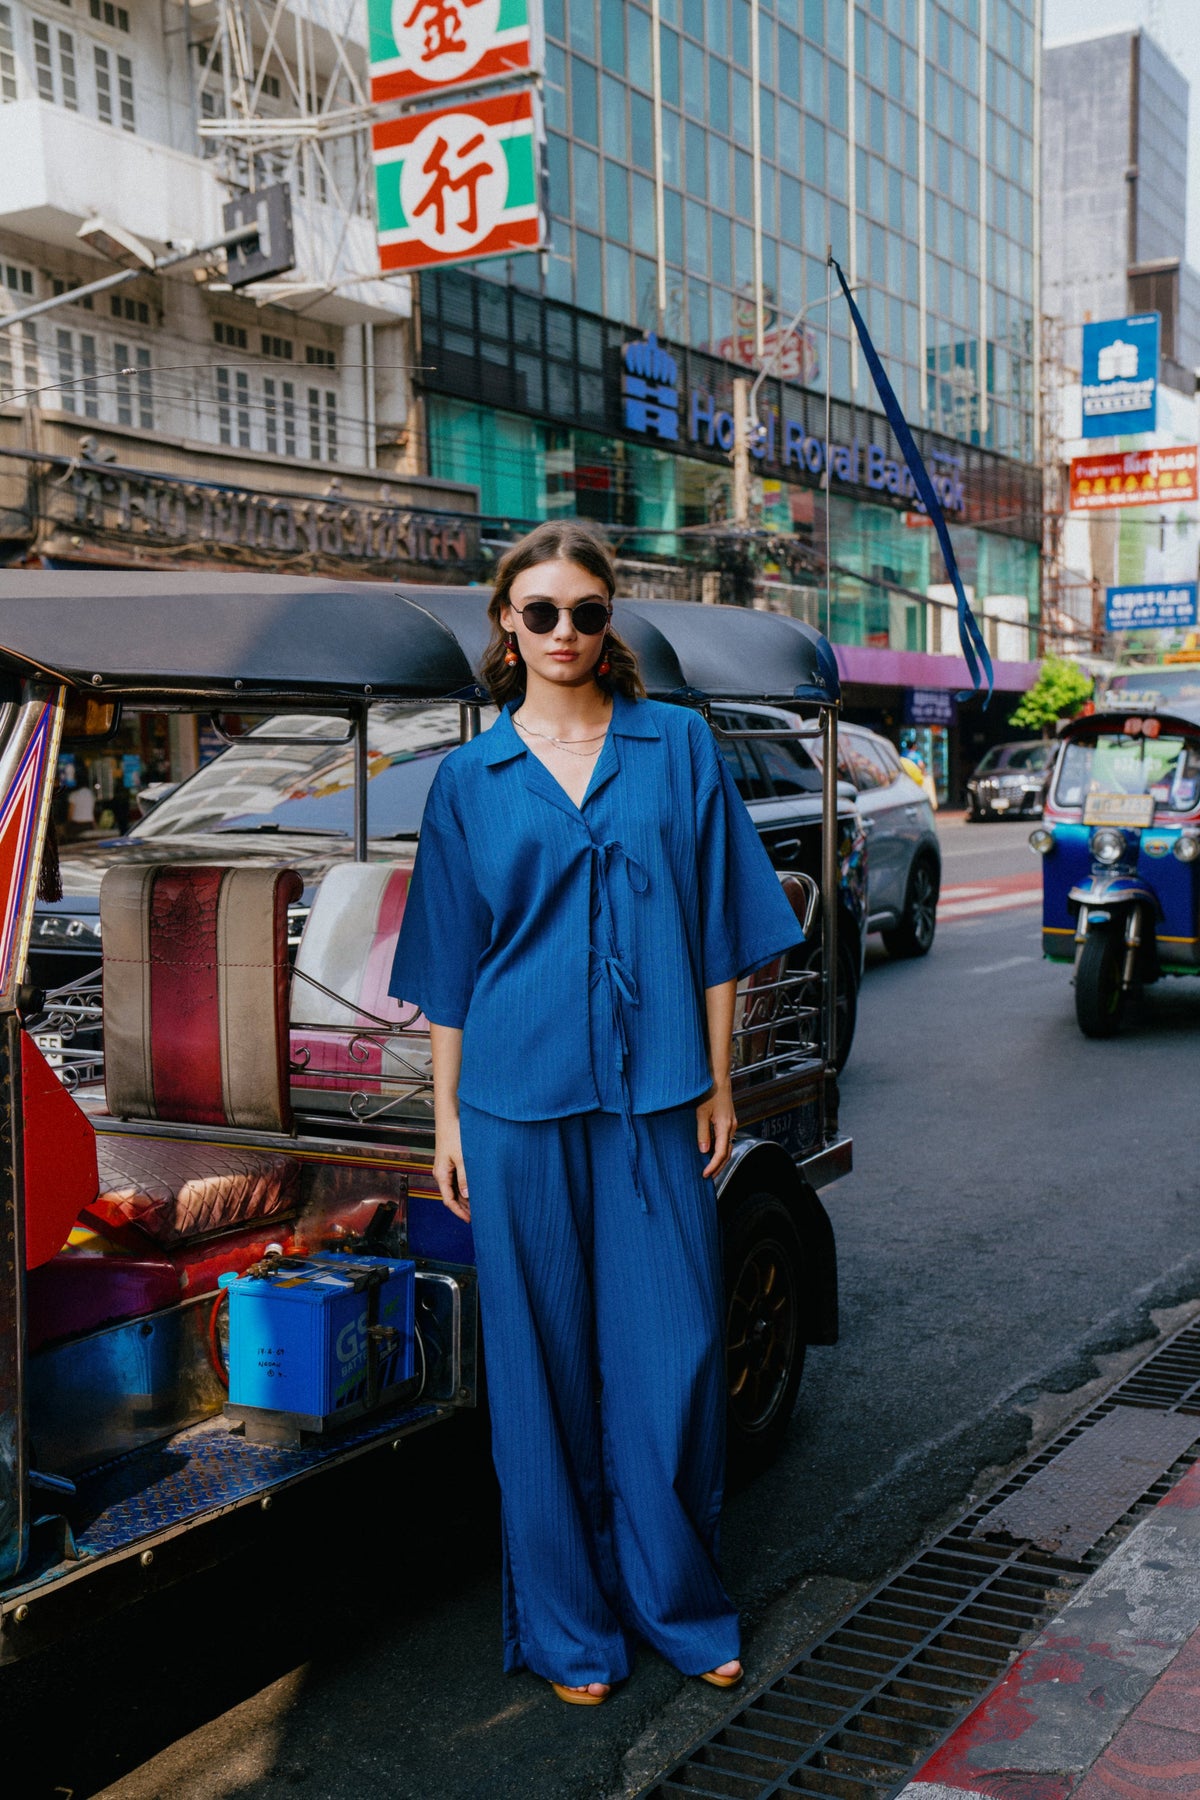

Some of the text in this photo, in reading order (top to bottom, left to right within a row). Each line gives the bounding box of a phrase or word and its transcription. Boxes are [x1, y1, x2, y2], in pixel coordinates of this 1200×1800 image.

[412, 132, 494, 236] 行
[691, 389, 775, 462] Hoel
[785, 420, 859, 489] Royal
